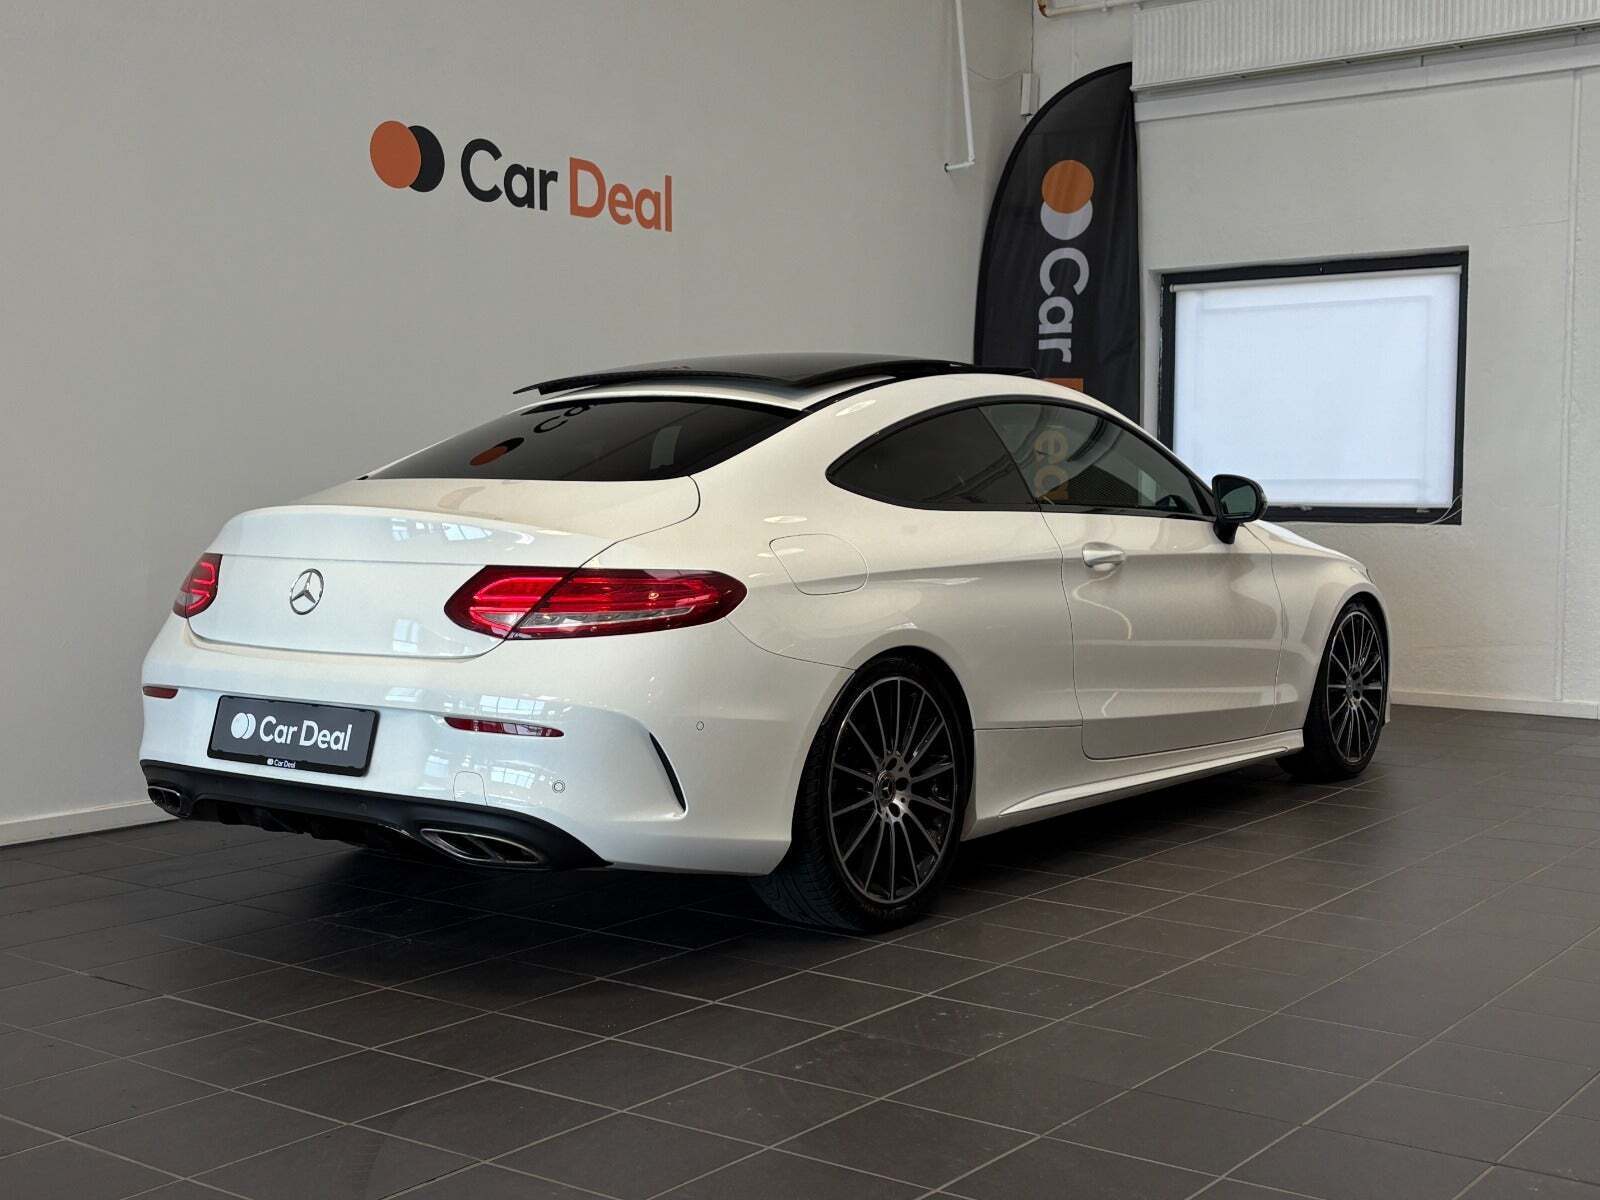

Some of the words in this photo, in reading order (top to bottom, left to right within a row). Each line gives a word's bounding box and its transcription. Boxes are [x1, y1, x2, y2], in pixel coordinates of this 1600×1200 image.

[460, 138, 558, 211] Car
[569, 157, 673, 232] Deal
[1038, 247, 1090, 363] Car
[259, 715, 299, 744] Car
[299, 720, 352, 751] Deal
[274, 758, 284, 767] Car
[284, 760, 296, 769] Deal
